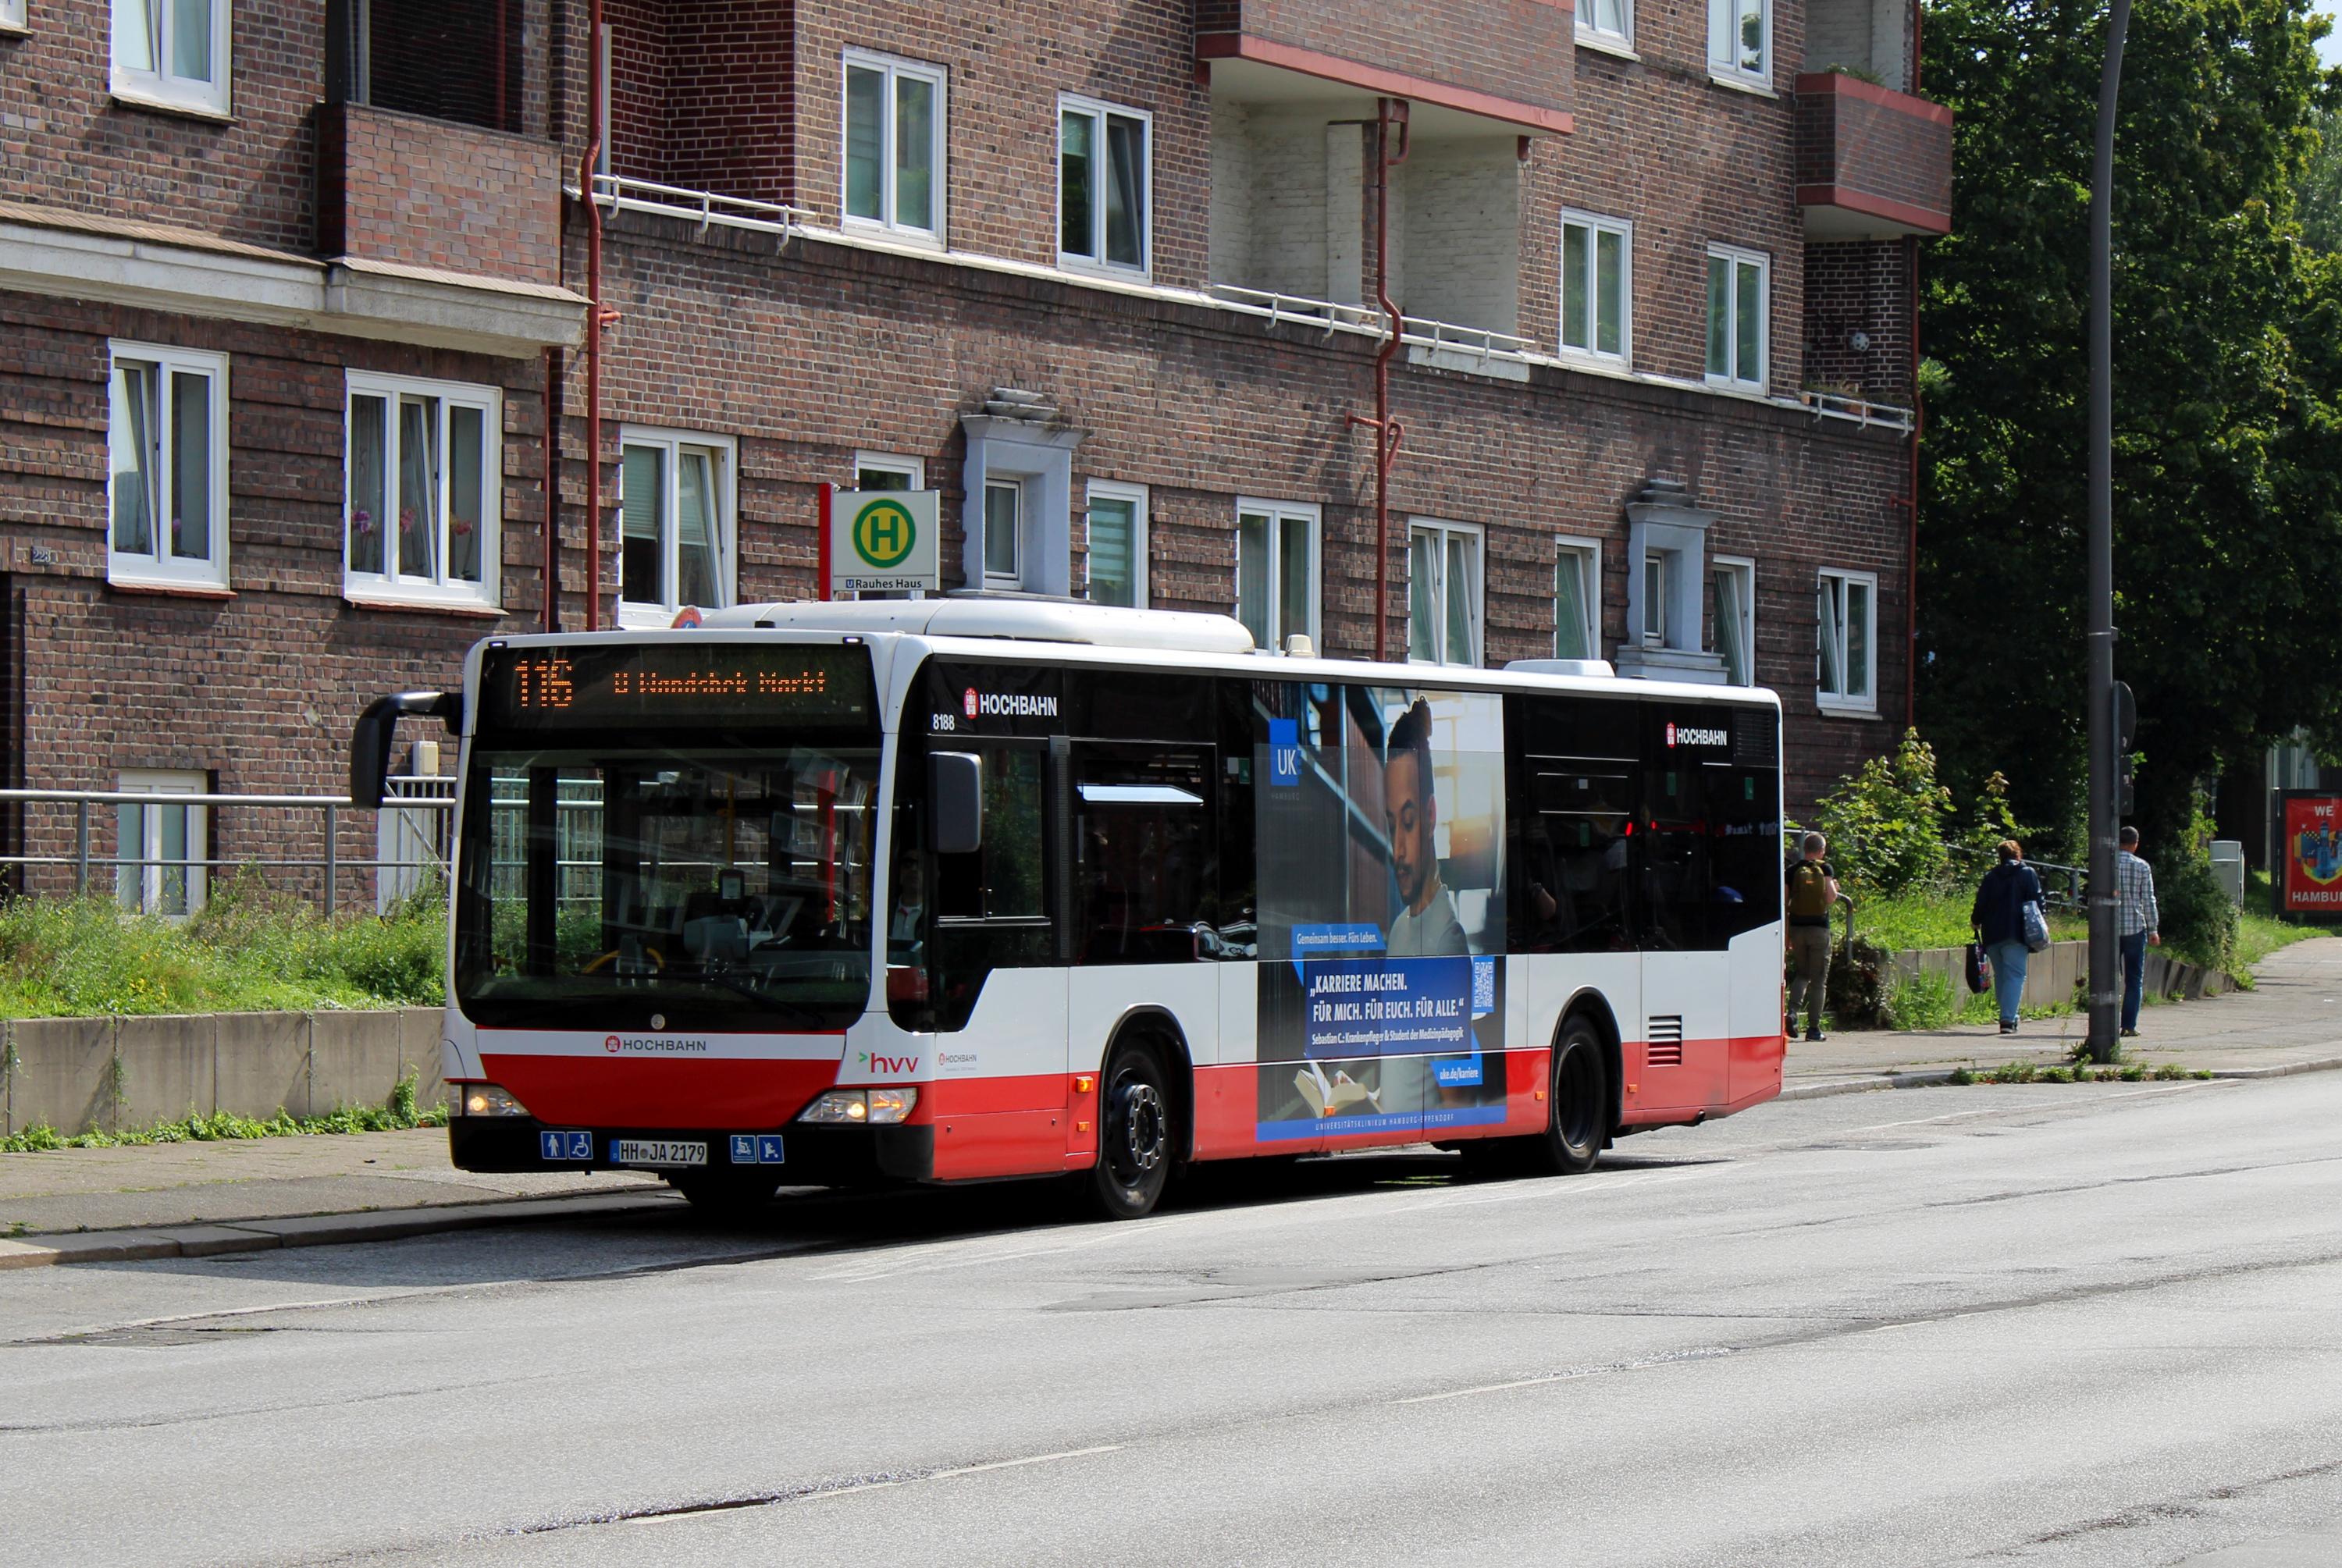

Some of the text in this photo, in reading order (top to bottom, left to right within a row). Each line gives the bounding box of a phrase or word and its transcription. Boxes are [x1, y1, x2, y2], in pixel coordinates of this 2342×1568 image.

[870, 515, 899, 552] H
[33, 548, 52, 563] 228
[856, 579, 894, 588] Rauhes
[895, 579, 922, 588] Haus
[515, 660, 572, 707] 116
[980, 694, 1057, 716] HOCHBAHN
[933, 713, 955, 731] 8188
[1676, 727, 1728, 745] HOCHBAHN
[2315, 805, 2334, 817] WE
[1297, 931, 1378, 944] Gemeinsam besser. Fürs Leben.
[1364, 973, 1408, 991] MACHEN.
[1313, 998, 1332, 1022] FÜR
[1334, 1002, 1362, 1021] MICH.
[1365, 998, 1384, 1020] FÜR
[1386, 1001, 1413, 1019] EUCH.
[1415, 996, 1433, 1018] FÜR
[1312, 1032, 1337, 1045] Sebastian
[1345, 1030, 1384, 1046] Krankenpfleger
[1384, 1030, 1390, 1041] &
[1390, 1029, 1410, 1041] Student
[1410, 1029, 1419, 1040] der
[1419, 1026, 1465, 1043] Medizinpädagogik
[623, 1040, 707, 1051] HOCHBAHN
[870, 1052, 919, 1074] hvv
[945, 1054, 977, 1064] HOCHBAHN
[1315, 1114, 1454, 1131] UNIVERSITÄTSKLINIKUM HAMBURG-EPPENDORF
[621, 1143, 706, 1162] HH JA 2179
